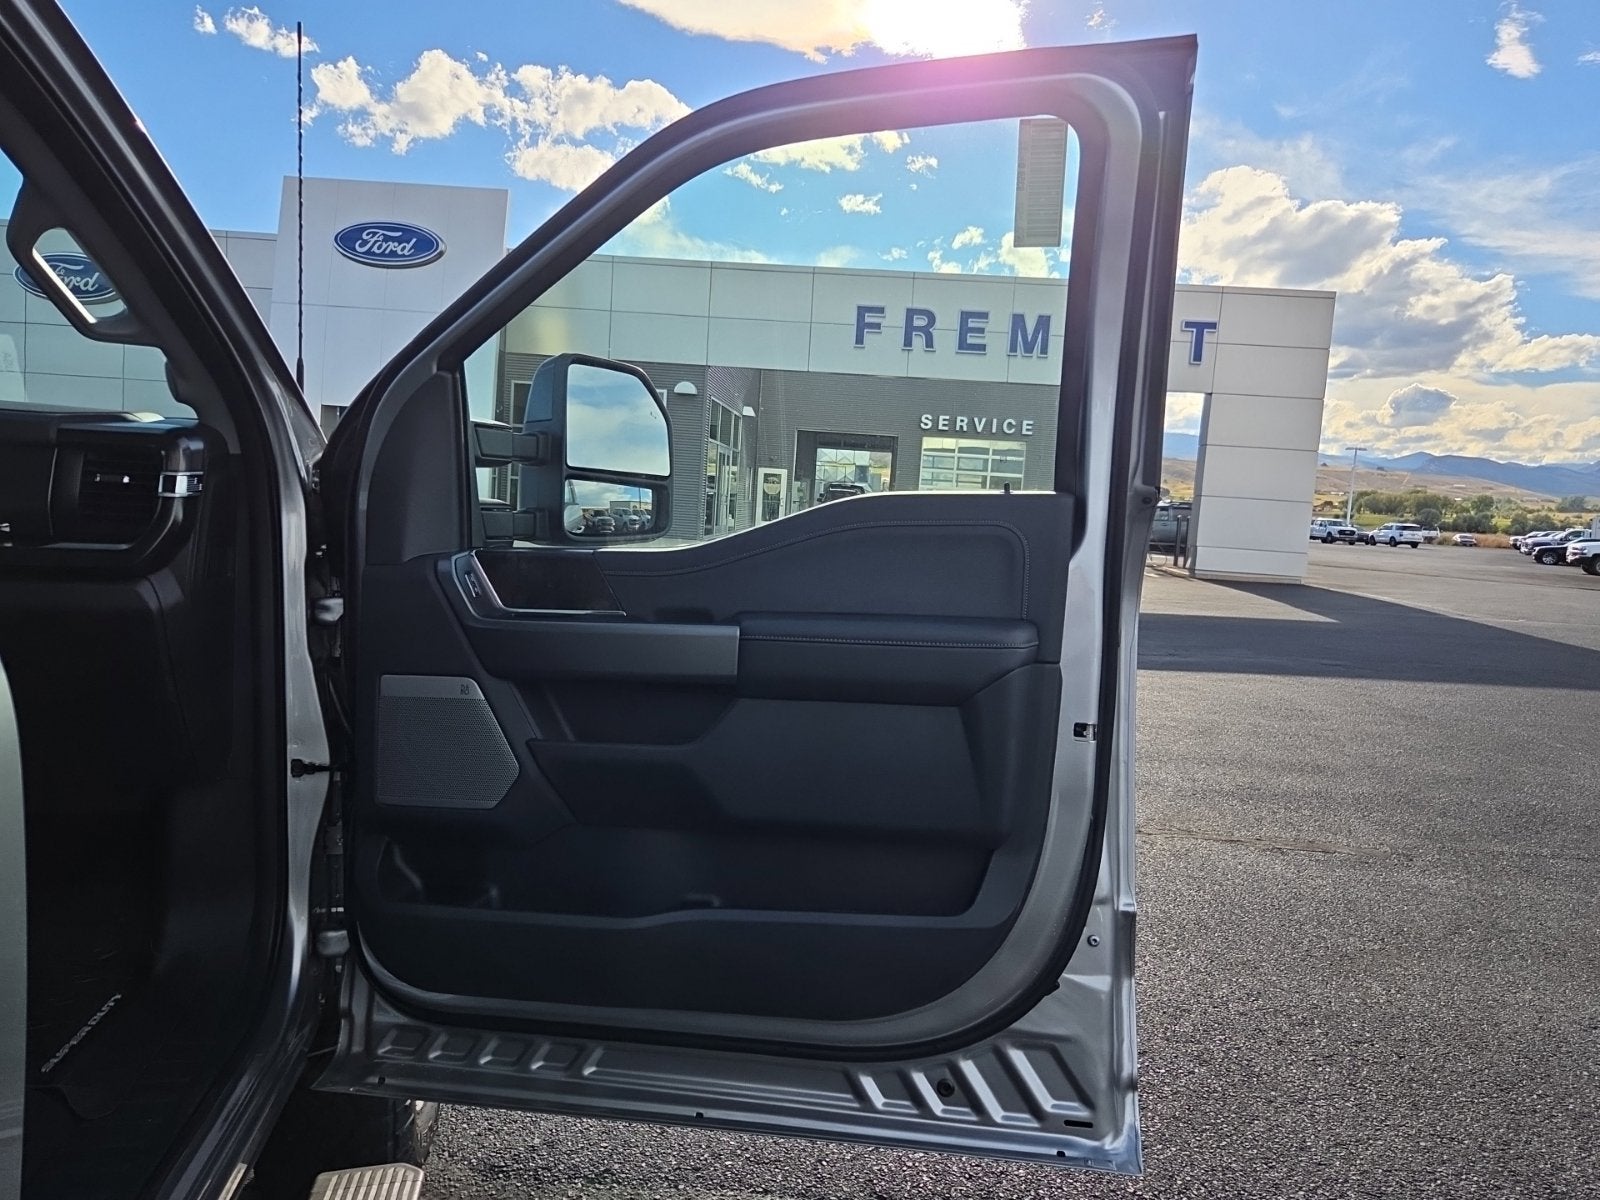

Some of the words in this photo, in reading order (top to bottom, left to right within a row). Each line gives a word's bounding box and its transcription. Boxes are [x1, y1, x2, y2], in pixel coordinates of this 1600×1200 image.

[355, 229, 418, 256] Ford
[853, 305, 1217, 365] FREMT
[920, 413, 1035, 436] SERVICE
